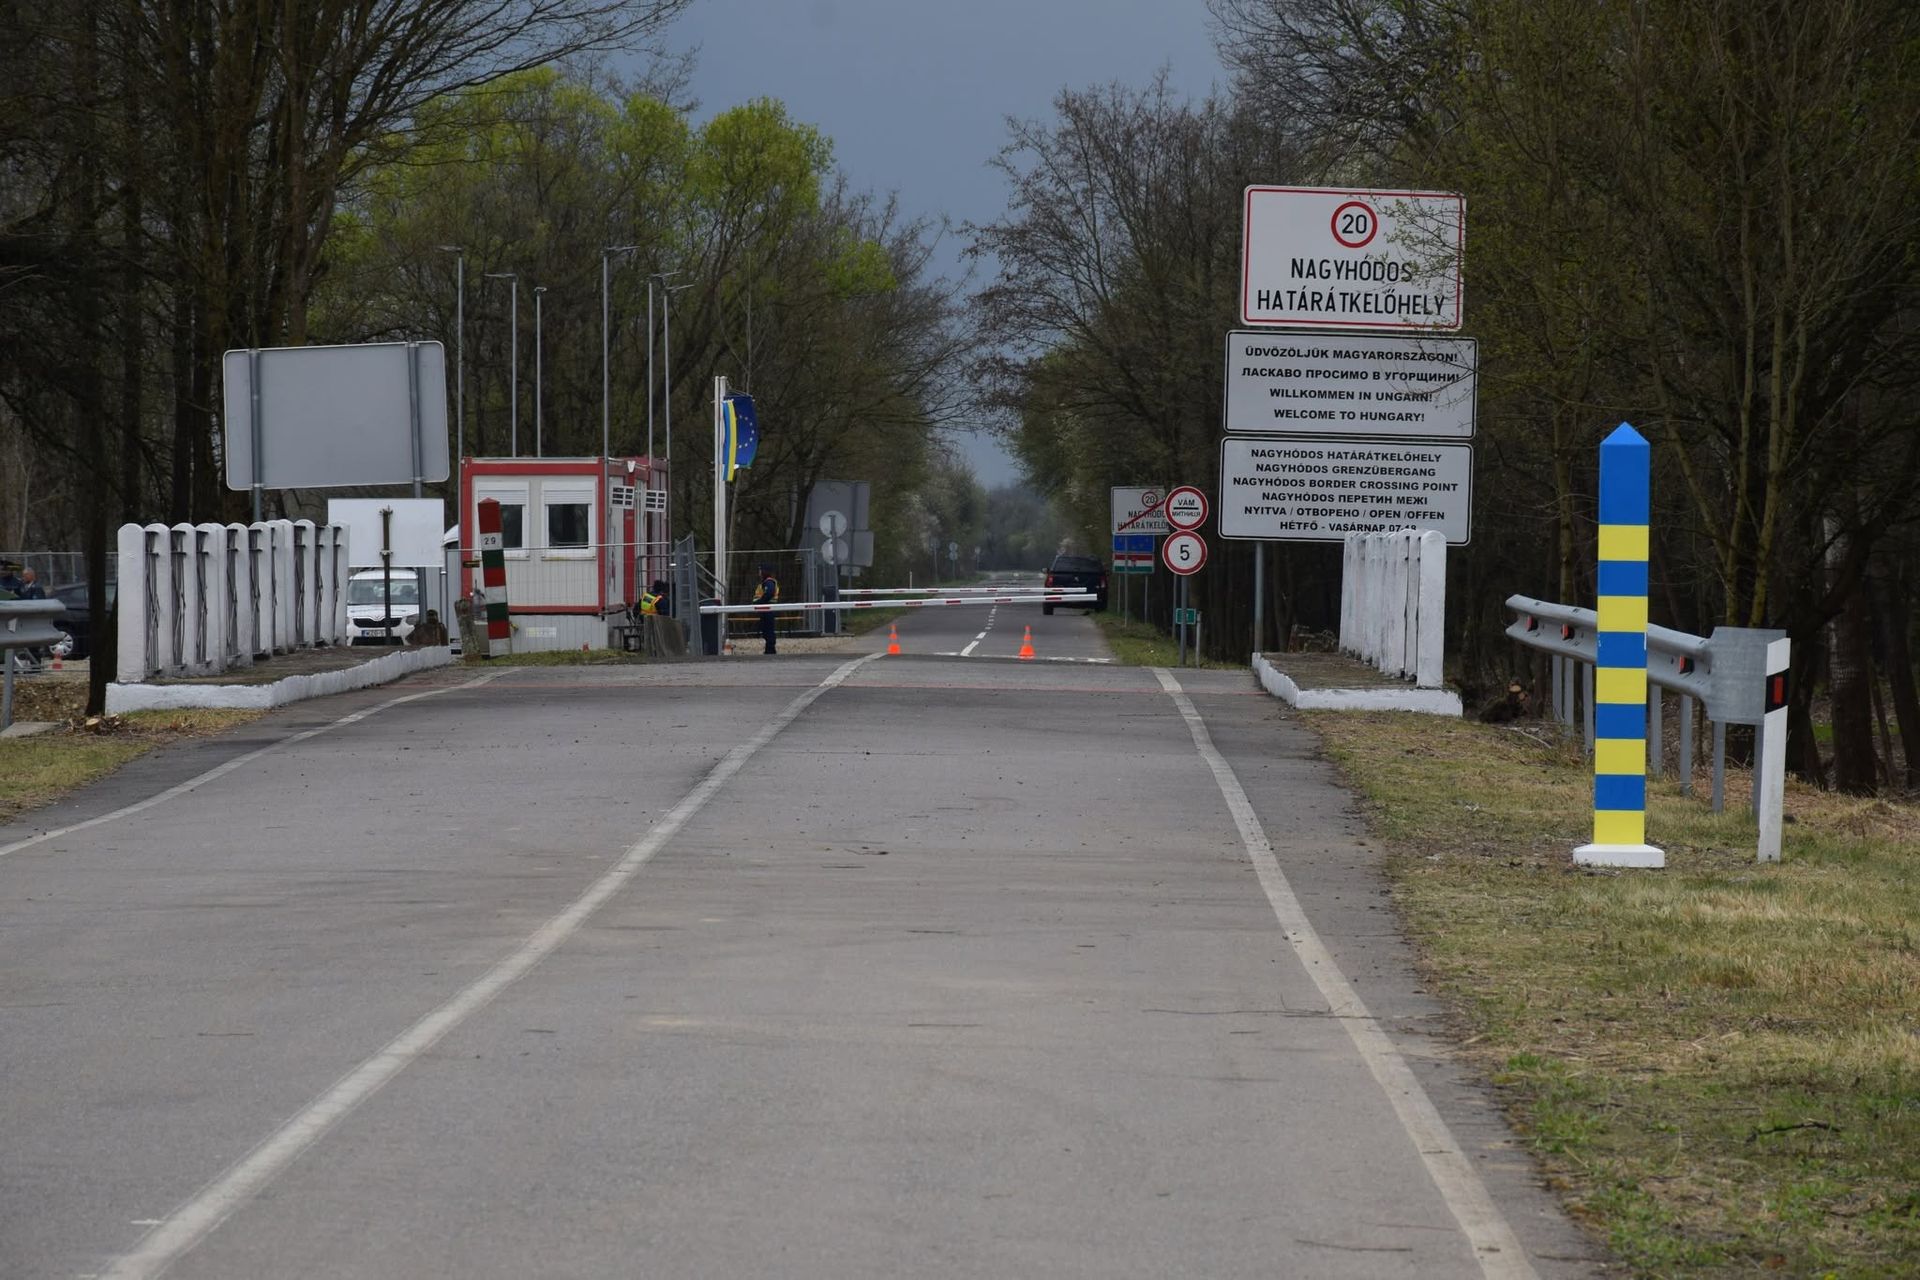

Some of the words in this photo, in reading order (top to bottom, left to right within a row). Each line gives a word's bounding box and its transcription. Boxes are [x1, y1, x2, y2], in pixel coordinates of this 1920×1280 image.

[1342, 214, 1367, 234] 20
[1291, 255, 1413, 282] NAGYHÓDOS
[1258, 286, 1445, 316] HATÁRÁTKELŐHELY
[1246, 346, 1328, 359] ÜDVÖZÖLJÜK
[1242, 368, 1301, 378] ЛАСКАВО
[1306, 370, 1368, 380] ПРОСИМО
[1373, 371, 1380, 380] В
[1270, 389, 1354, 400] WILLKOMMEN
[1359, 391, 1371, 400] IN
[1376, 392, 1432, 402] UNGARN!
[1274, 409, 1335, 419] WELCOME
[1339, 411, 1355, 420] TO
[1360, 412, 1424, 422] HUNGARY!
[1251, 449, 1323, 459] NAGYHÓDOS
[1327, 450, 1441, 462] HATÁRÁTKELŐHELY
[1256, 463, 1328, 474] NAGYHÓDOS
[1332, 465, 1436, 477] GRENZÜBERGANG
[1233, 477, 1305, 487] NAGYHÓDOS
[1309, 480, 1355, 489] BORDER
[1360, 481, 1419, 491] CROSSING
[1423, 483, 1458, 491] POINT
[1178, 498, 1195, 506] VÁM
[1262, 492, 1334, 502] NAGYHÓDOS
[1339, 495, 1392, 504] ПЕРЕТИН
[1245, 507, 1286, 516] NYITVA
[1370, 510, 1401, 519] OPEN
[1329, 522, 1385, 532] VASÁRNAP
[484, 537, 495, 545] 29
[1180, 545, 1190, 560] 5
